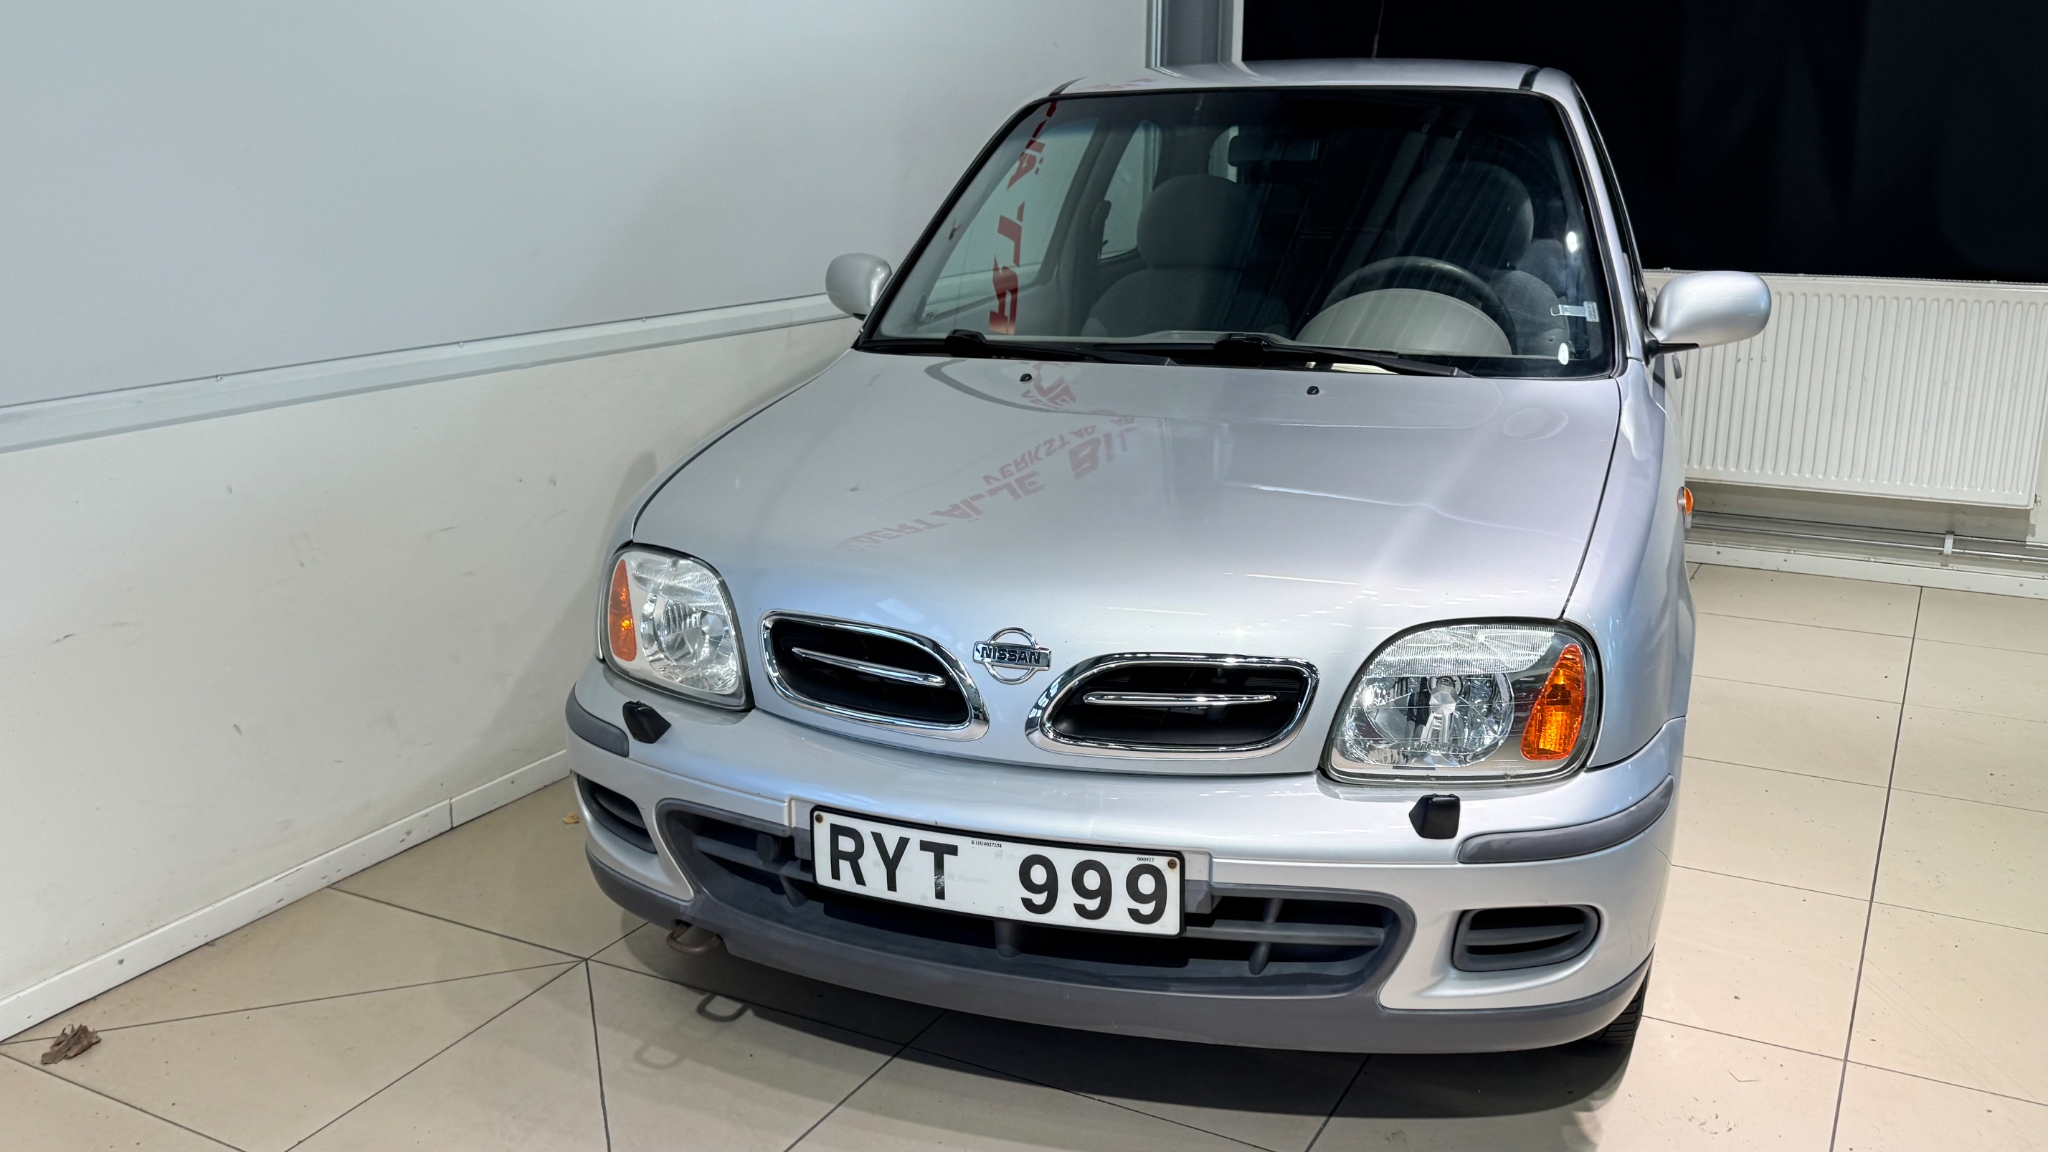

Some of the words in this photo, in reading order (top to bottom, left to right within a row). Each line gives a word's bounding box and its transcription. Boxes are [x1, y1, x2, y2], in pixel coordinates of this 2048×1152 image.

[980, 646, 1041, 665] NISSAN
[829, 822, 959, 901] RYT
[1018, 853, 1168, 925] 999
